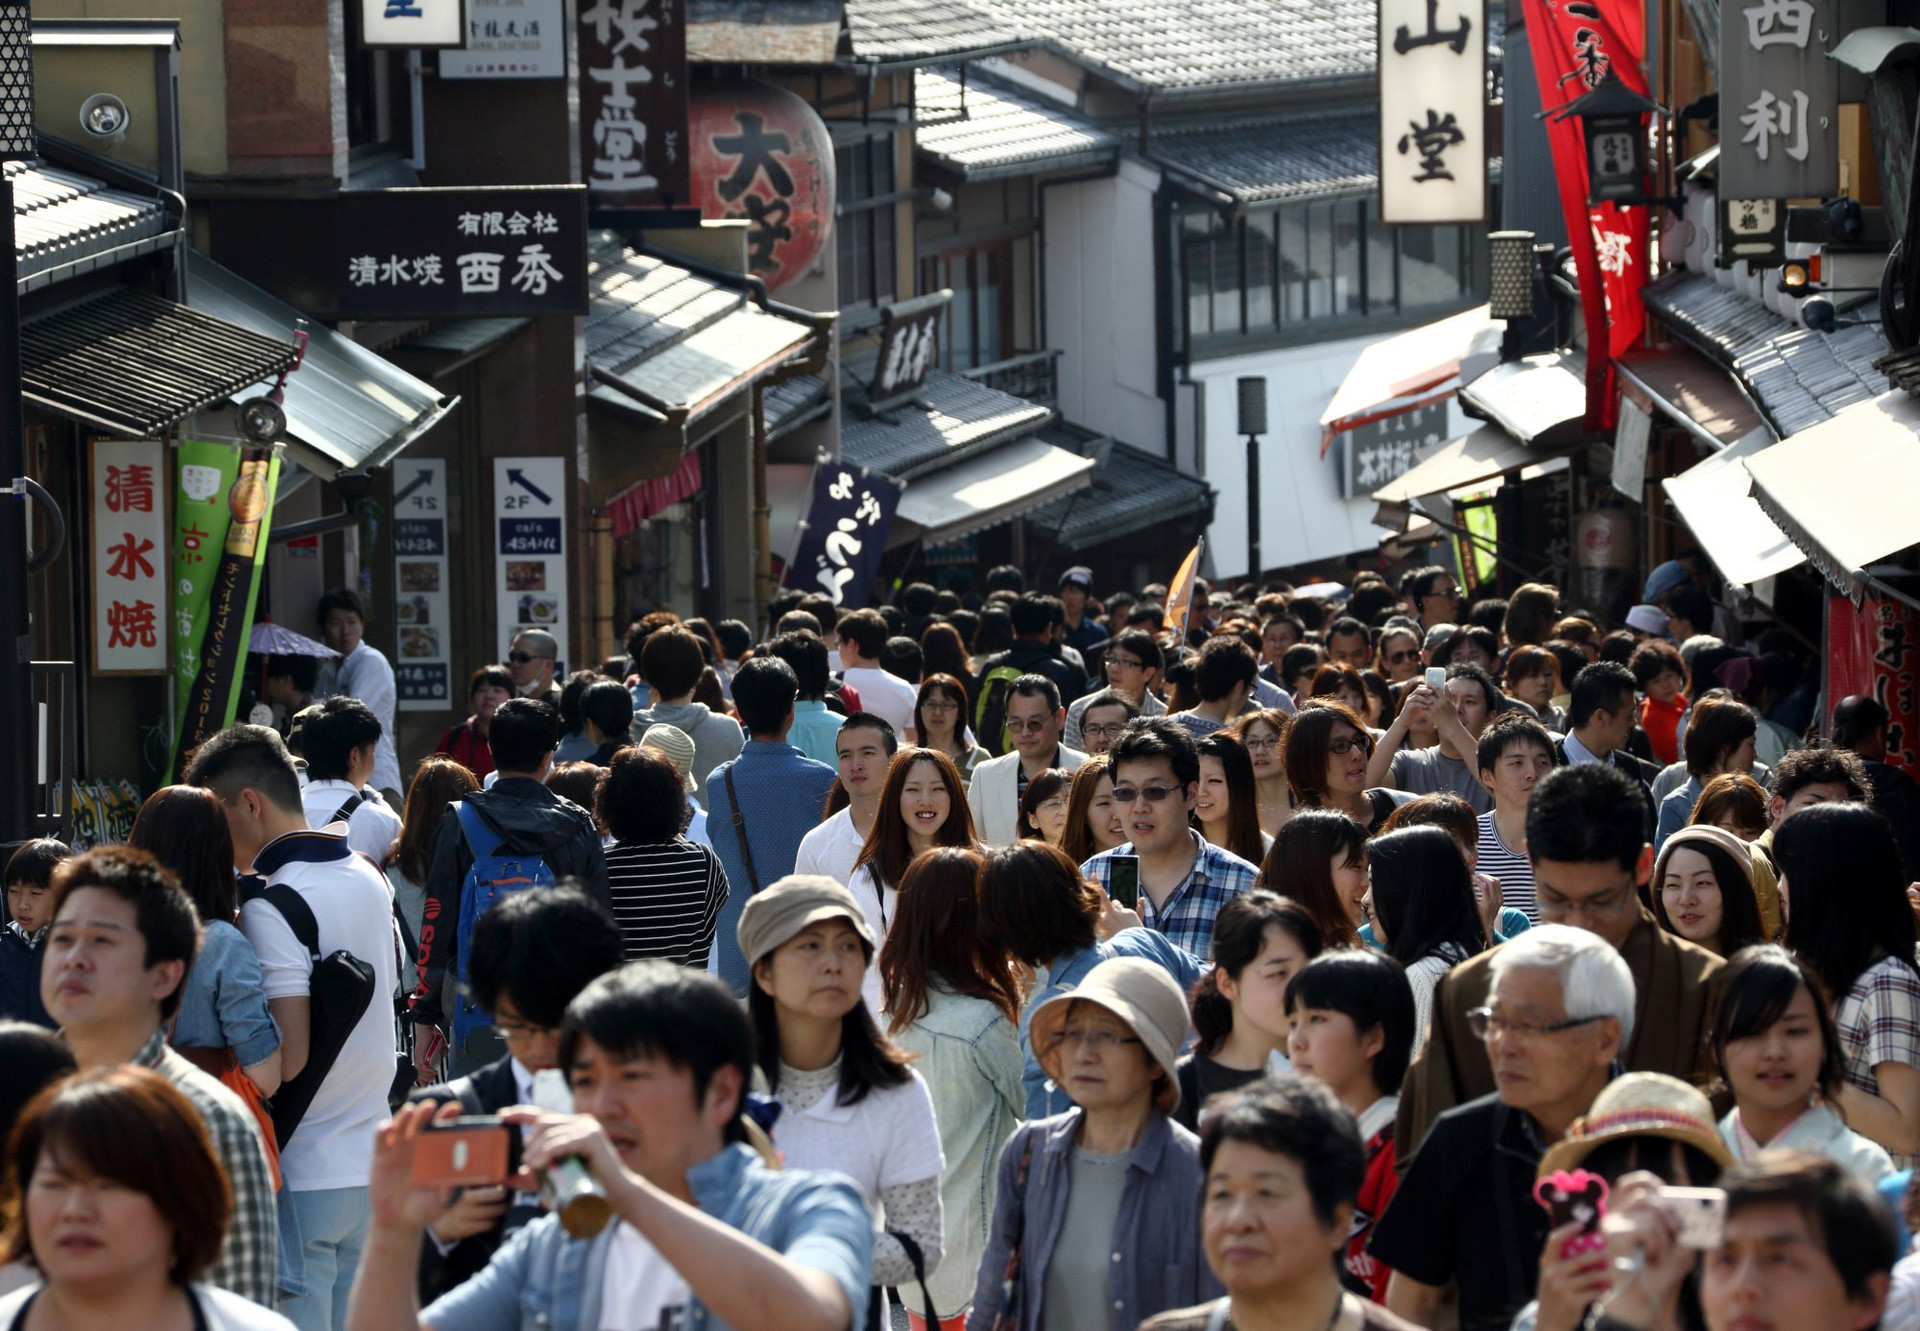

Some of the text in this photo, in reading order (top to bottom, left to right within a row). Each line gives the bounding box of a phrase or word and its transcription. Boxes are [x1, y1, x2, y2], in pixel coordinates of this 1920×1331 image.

[1393, 0, 1472, 183] 山堂
[1739, 0, 1815, 161] 西利
[457, 211, 559, 236] 有限会社
[1738, 200, 1759, 230] ツ橋
[349, 254, 445, 286] 清水焼
[456, 243, 564, 295] 西秀
[504, 496, 530, 510] 2F
[105, 464, 157, 649] 清水焼
